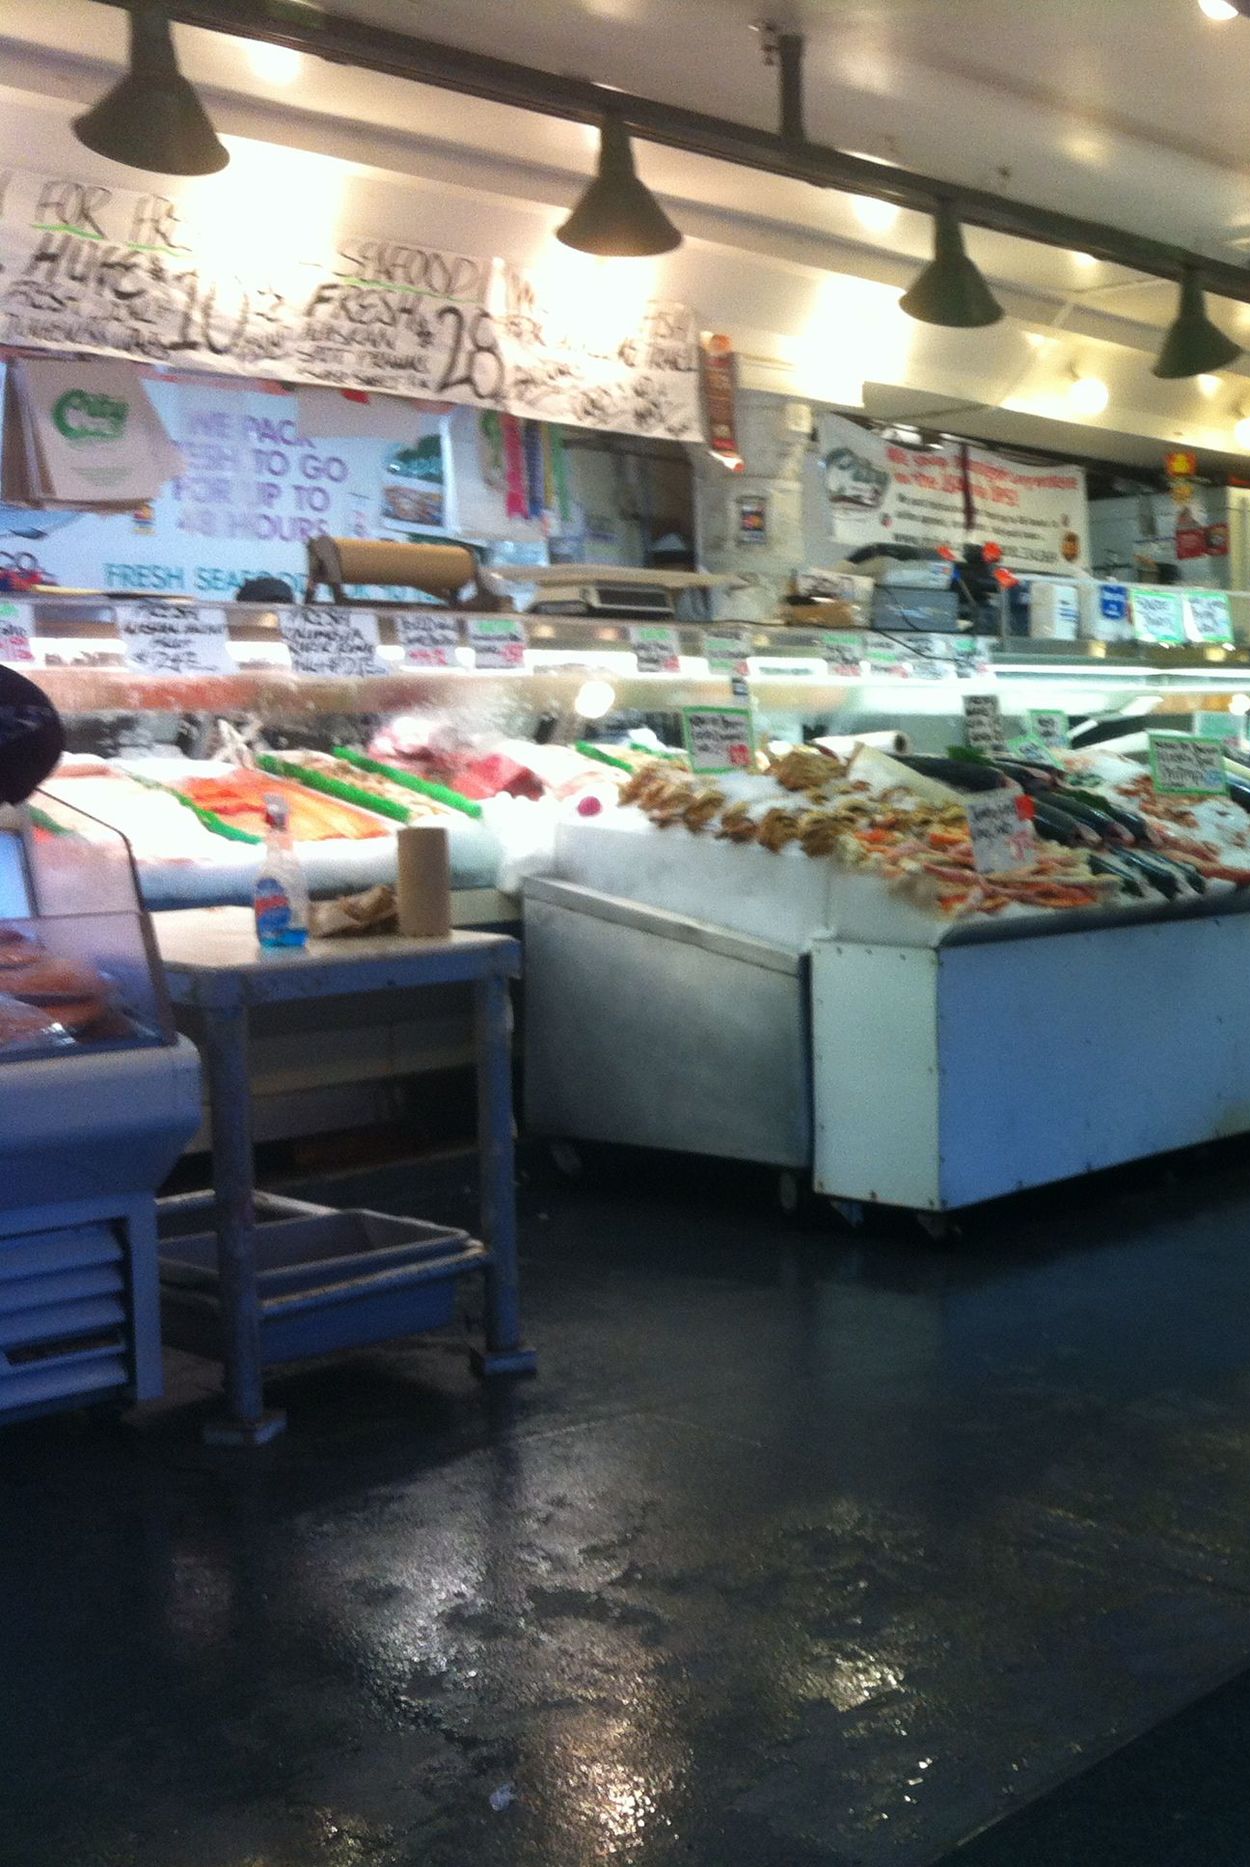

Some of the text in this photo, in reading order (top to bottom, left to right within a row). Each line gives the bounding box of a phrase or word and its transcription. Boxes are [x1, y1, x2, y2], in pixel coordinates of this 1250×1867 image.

[253, 448, 290, 476] TO
[301, 453, 350, 483] GO
[292, 484, 331, 512] TO
[103, 562, 184, 589] FRESH
